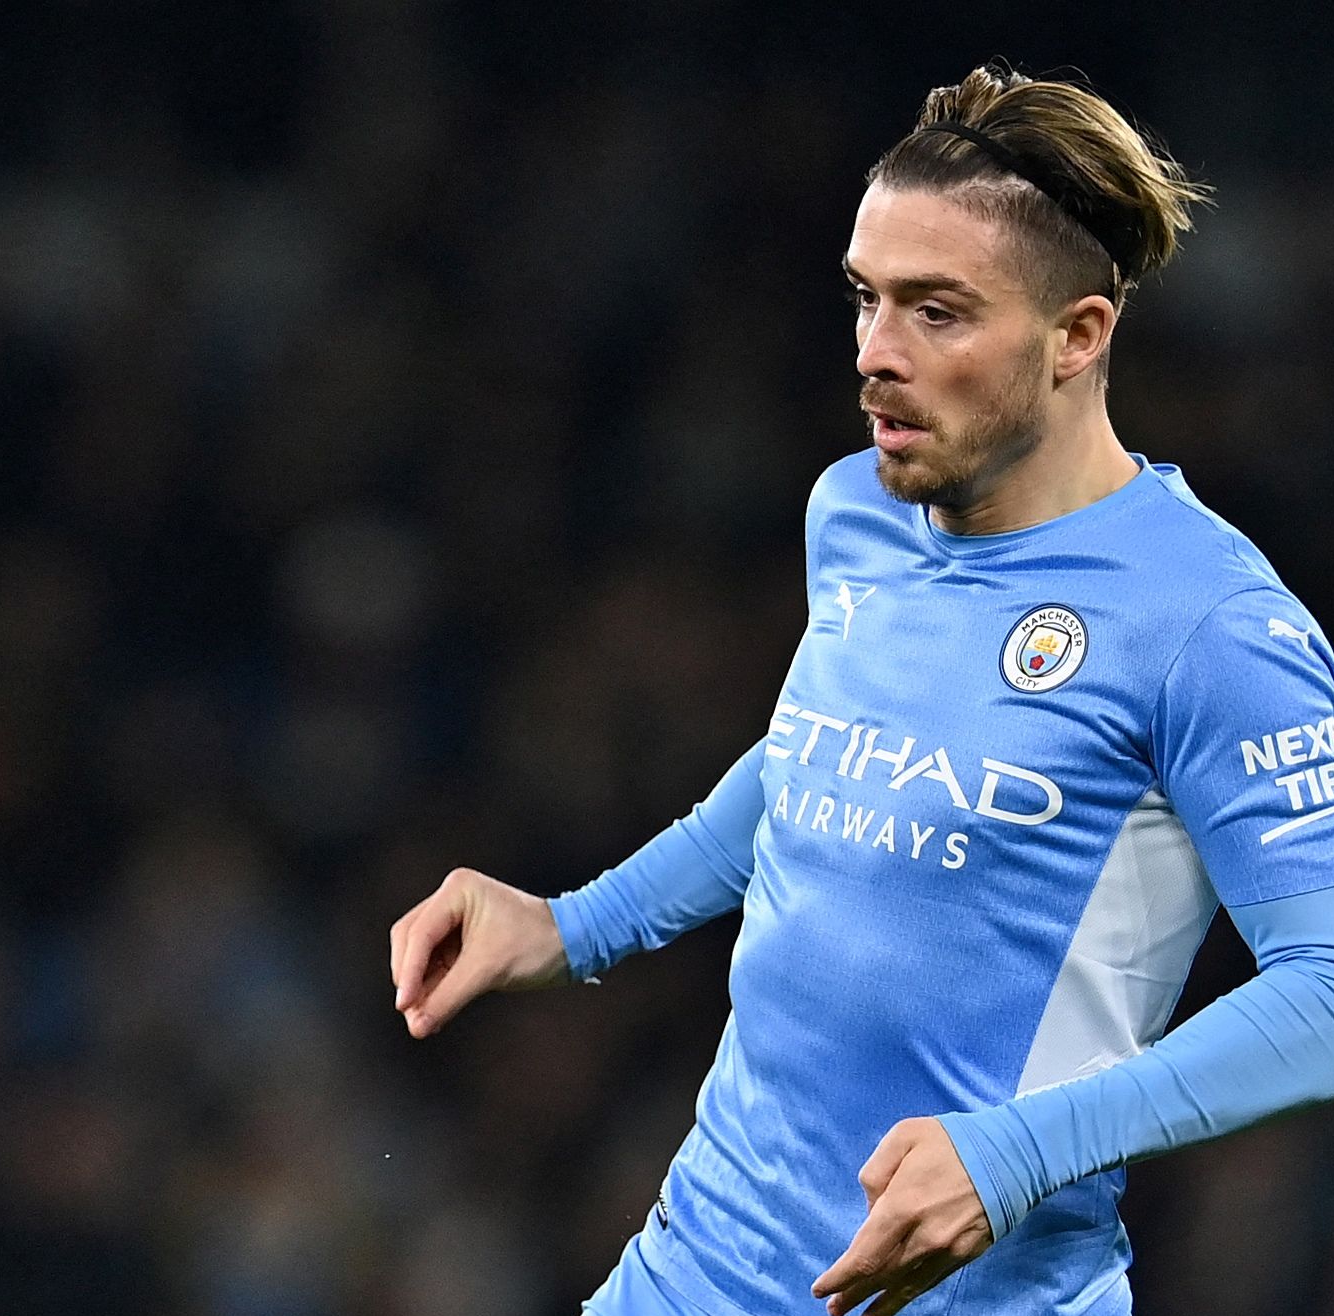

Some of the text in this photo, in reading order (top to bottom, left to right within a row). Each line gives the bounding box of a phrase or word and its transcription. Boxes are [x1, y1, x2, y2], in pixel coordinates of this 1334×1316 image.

[1021, 611, 1083, 647] MANCHESTER
[1015, 676, 1040, 688] CITY
[766, 703, 1063, 826] ETIHAD
[772, 784, 969, 870] AIRWAYS
